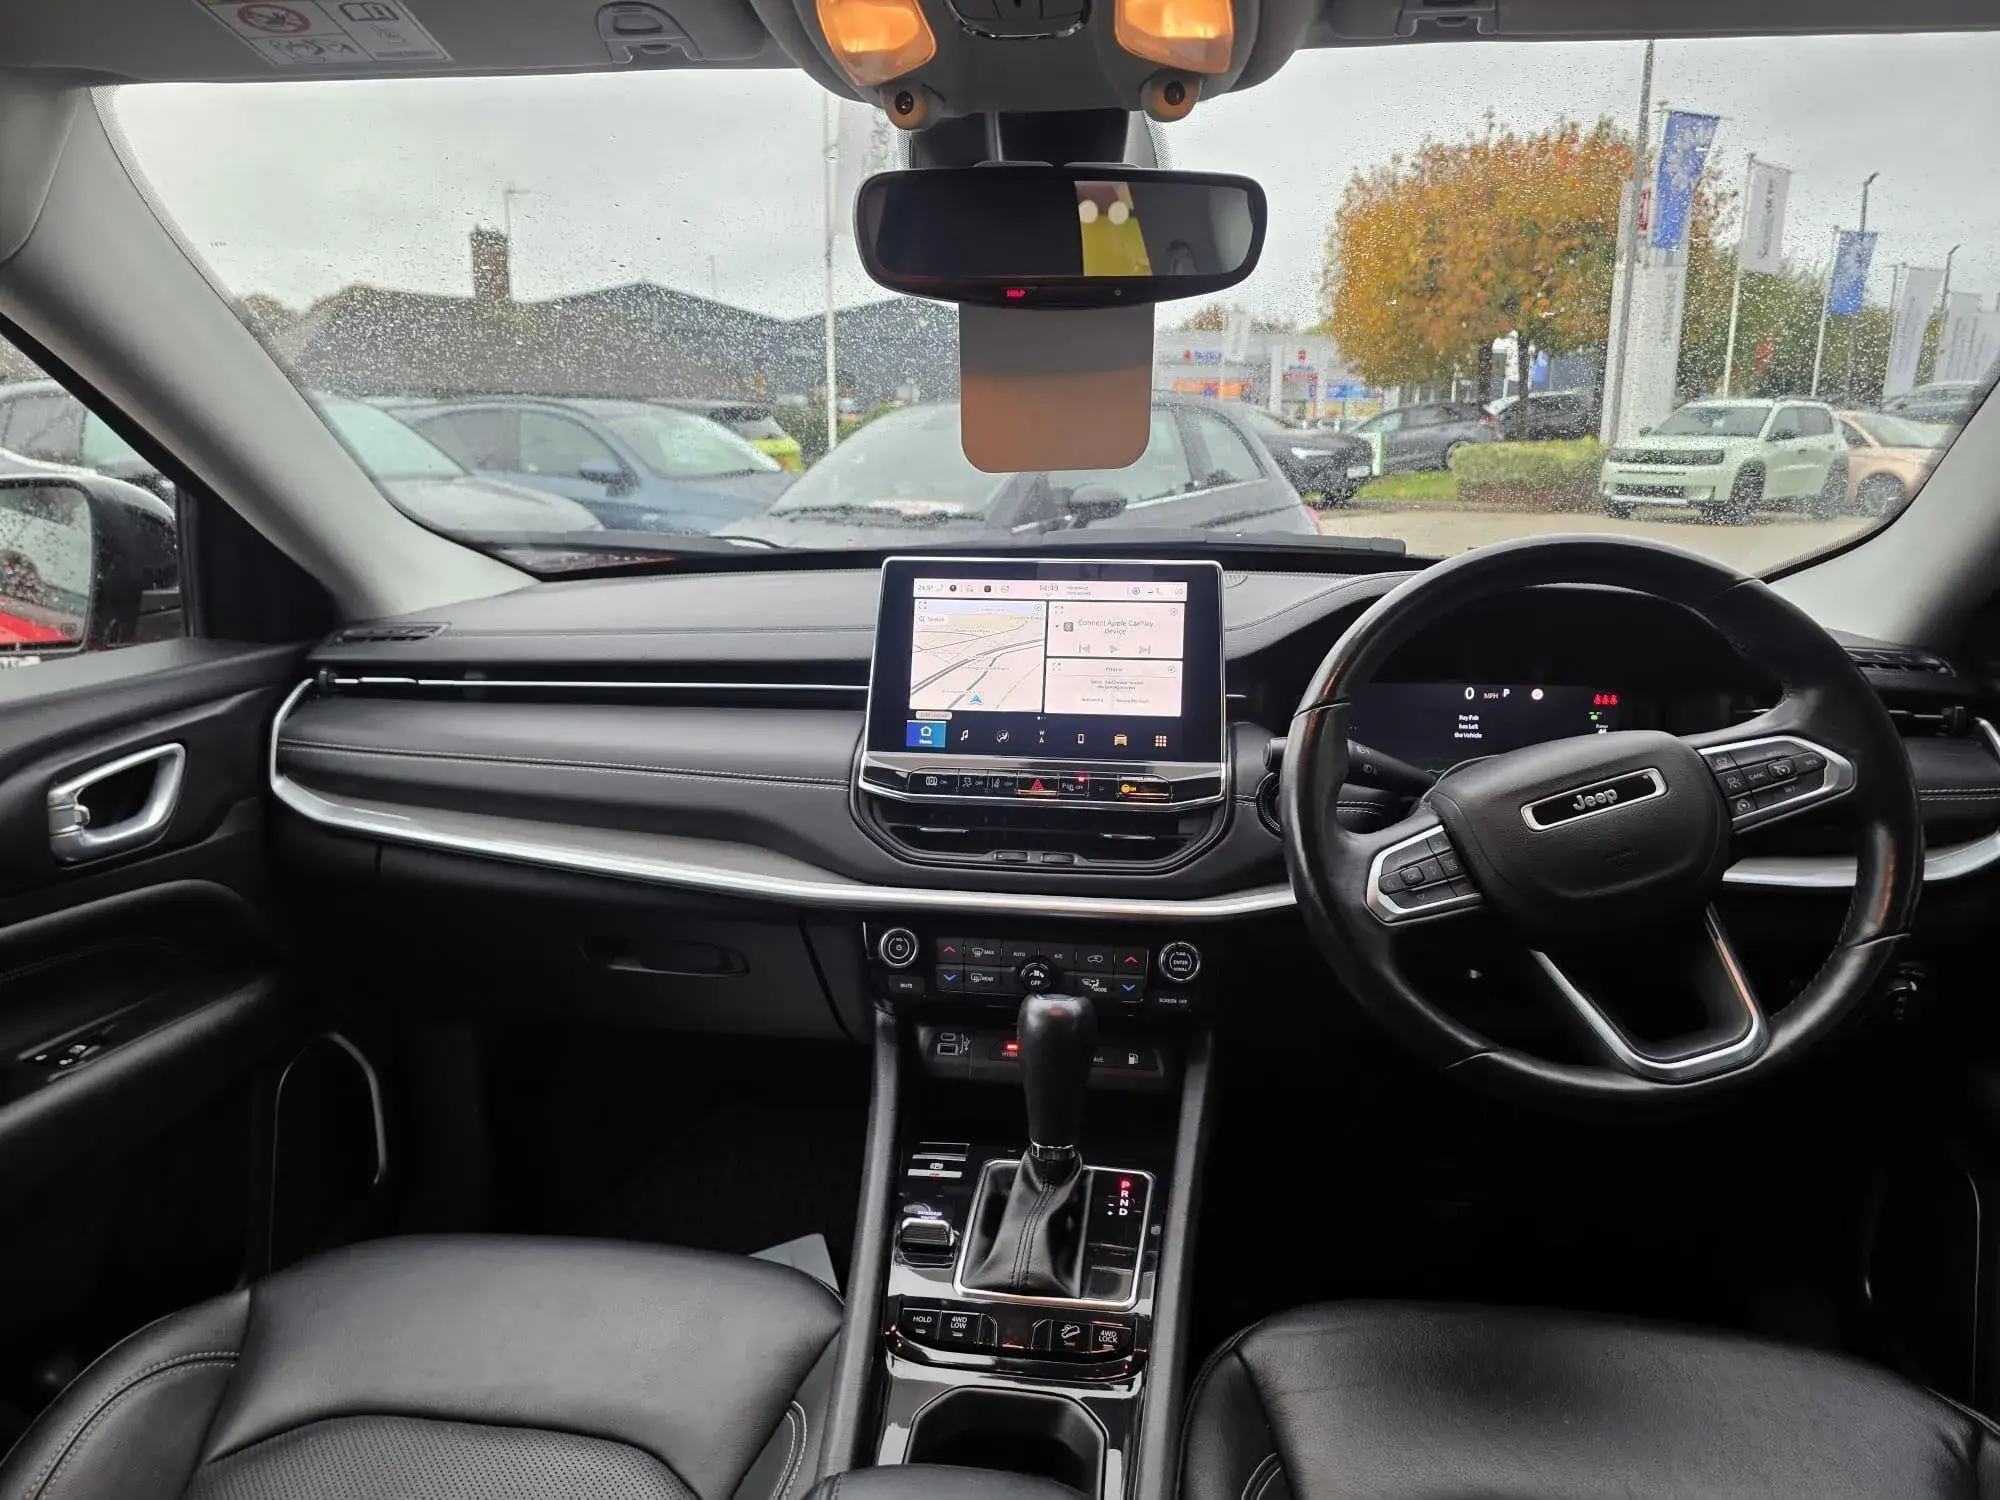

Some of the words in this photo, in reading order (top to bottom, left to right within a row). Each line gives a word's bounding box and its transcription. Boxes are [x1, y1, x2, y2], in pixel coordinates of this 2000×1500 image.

[1077, 619, 1105, 627] Connect
[1107, 620, 1127, 629] Apple
[1128, 620, 1154, 629] CarPlay
[1464, 686, 1475, 700] 0
[1503, 688, 1510, 697] P
[1572, 787, 1619, 811] Jeep
[1121, 1180, 1131, 1189] P
[1120, 1199, 1129, 1207] N
[1119, 1208, 1128, 1216] D
[913, 1315, 932, 1323] HOLD
[1100, 1329, 1117, 1337] 4WD
[1098, 1335, 1118, 1344] LOCK
